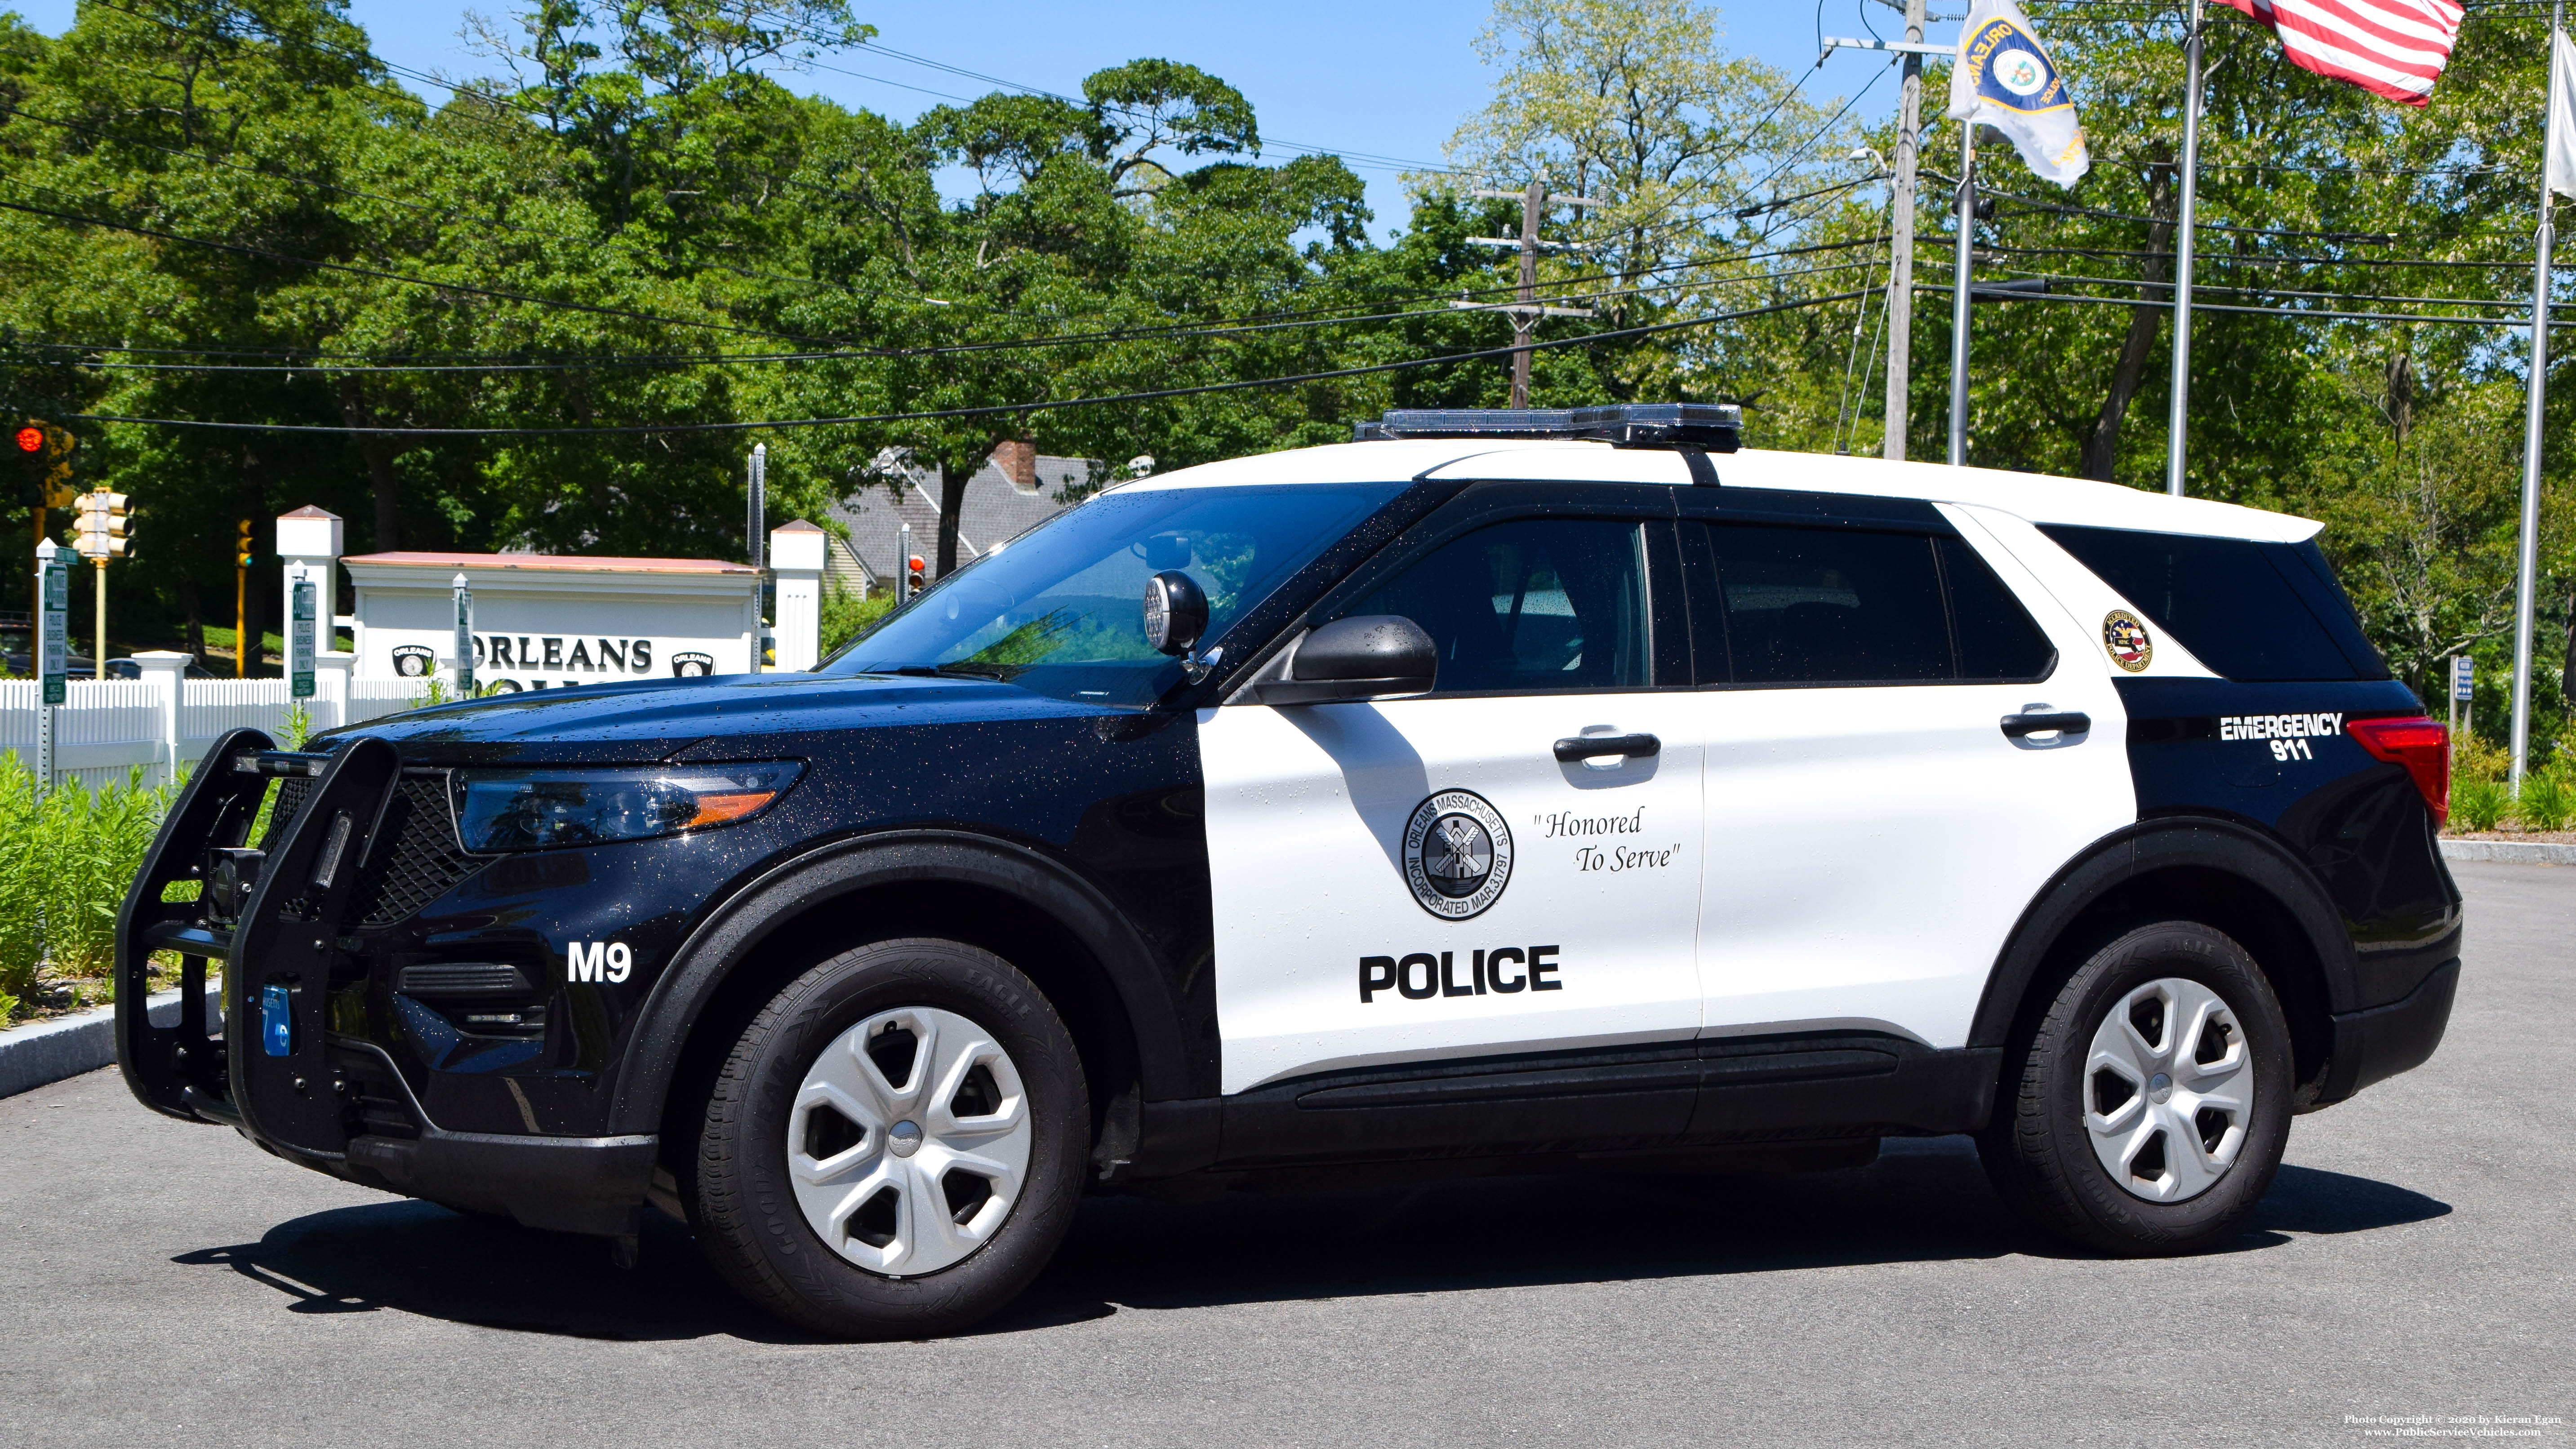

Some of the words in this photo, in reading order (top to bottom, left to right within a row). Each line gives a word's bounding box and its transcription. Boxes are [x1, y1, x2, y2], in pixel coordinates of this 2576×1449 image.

[2107, 612, 2140, 627] ACCREDITED
[394, 647, 432, 657] ORLEANS
[673, 653, 712, 664] ORLEANS
[2108, 644, 2124, 666] POLICE
[2125, 644, 2150, 669] DEPARTMENT
[2220, 713, 2342, 740] EMERGENCY
[2270, 739, 2313, 761] 911
[1534, 806, 1645, 838] "Honored
[1576, 845, 1604, 871] To
[1610, 843, 1680, 871] Serve"
[1409, 857, 1468, 914] INCORPORATED
[568, 942, 631, 983] M9
[1359, 945, 1562, 1003] POLICE
[262, 996, 280, 1010] HUSETTS
[963, 968, 1034, 1021] EAGLE
